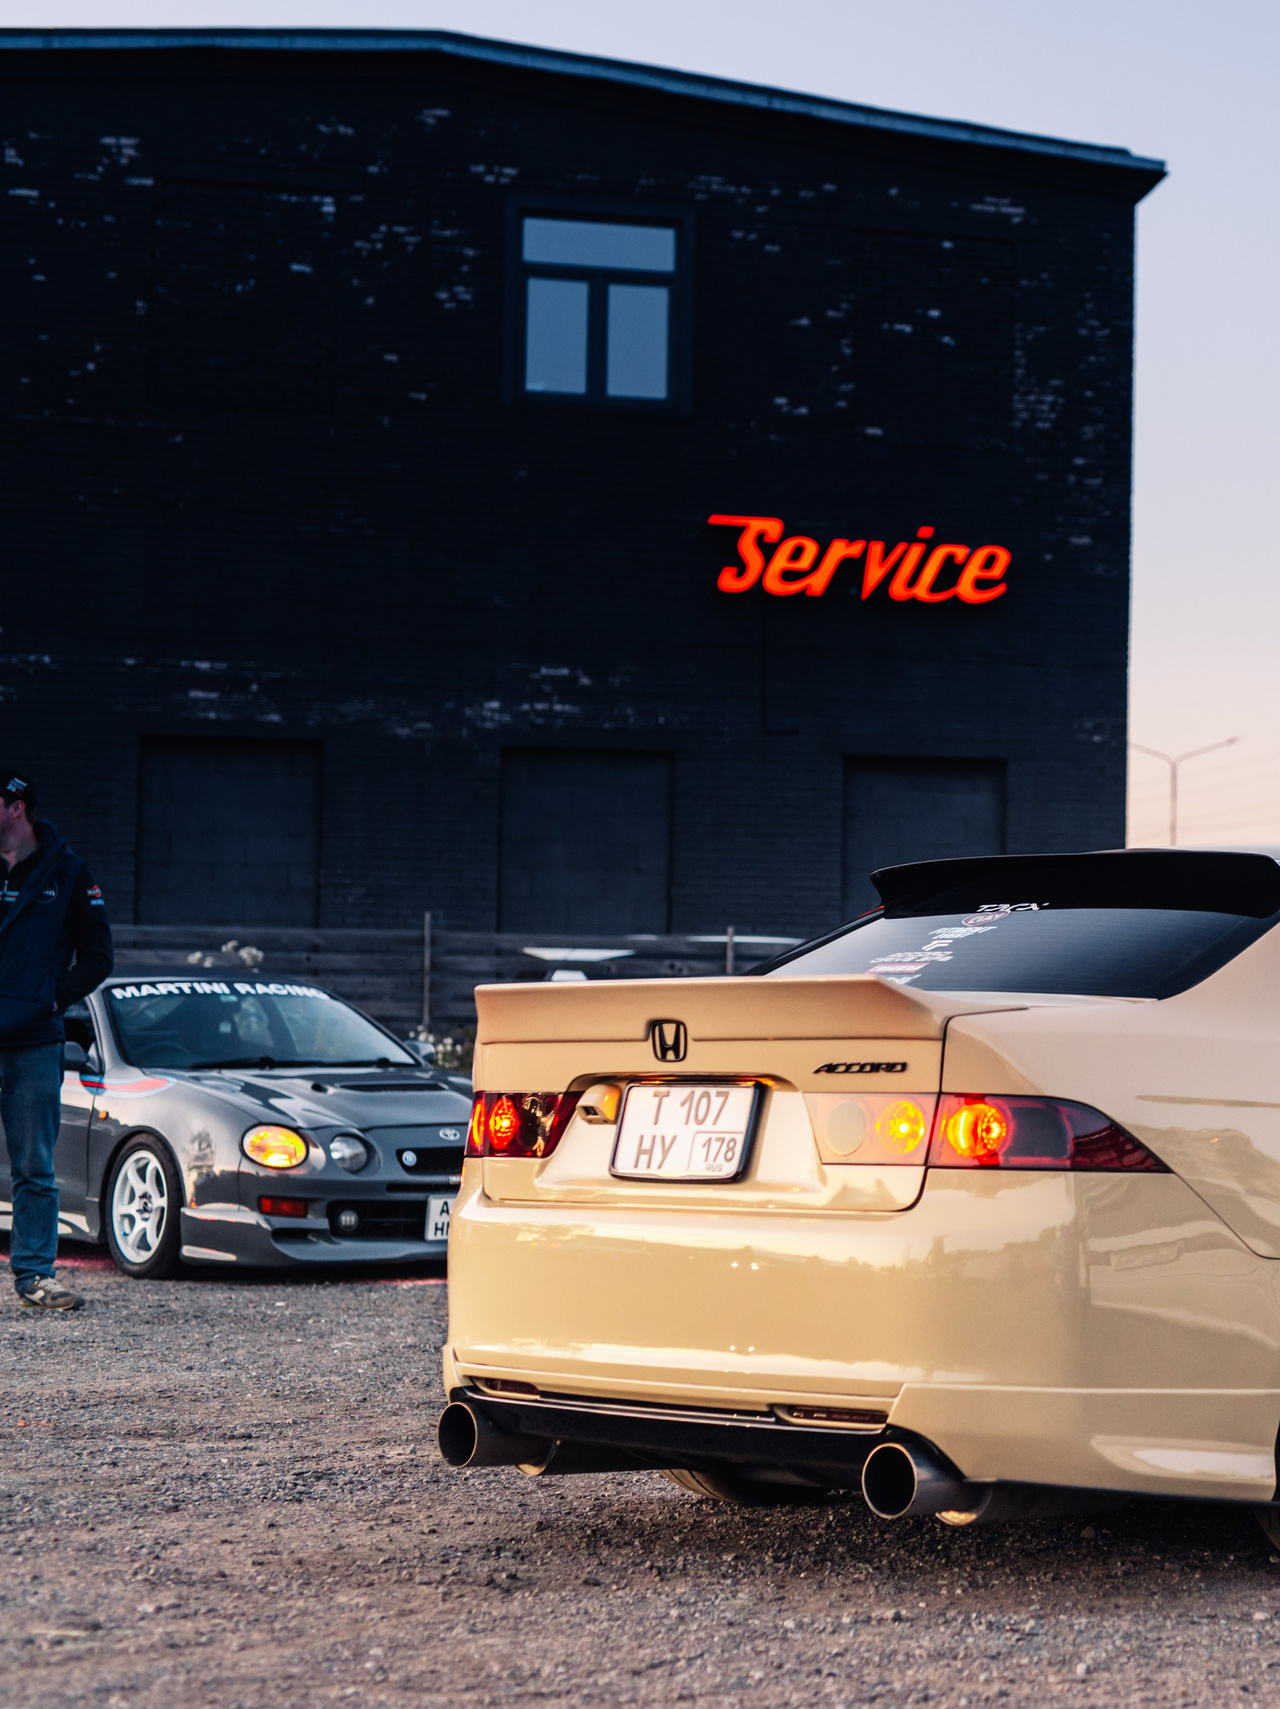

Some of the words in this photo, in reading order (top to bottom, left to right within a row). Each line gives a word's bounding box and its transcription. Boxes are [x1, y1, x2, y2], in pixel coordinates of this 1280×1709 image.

[707, 514, 1012, 604] Service
[111, 982, 231, 1000] MARTINI
[233, 983, 330, 1000] RACING
[812, 1061, 908, 1075] ACCORD
[652, 1089, 671, 1126] T
[679, 1090, 731, 1127] 107
[701, 1136, 738, 1164] 178
[705, 1163, 723, 1173] RUS
